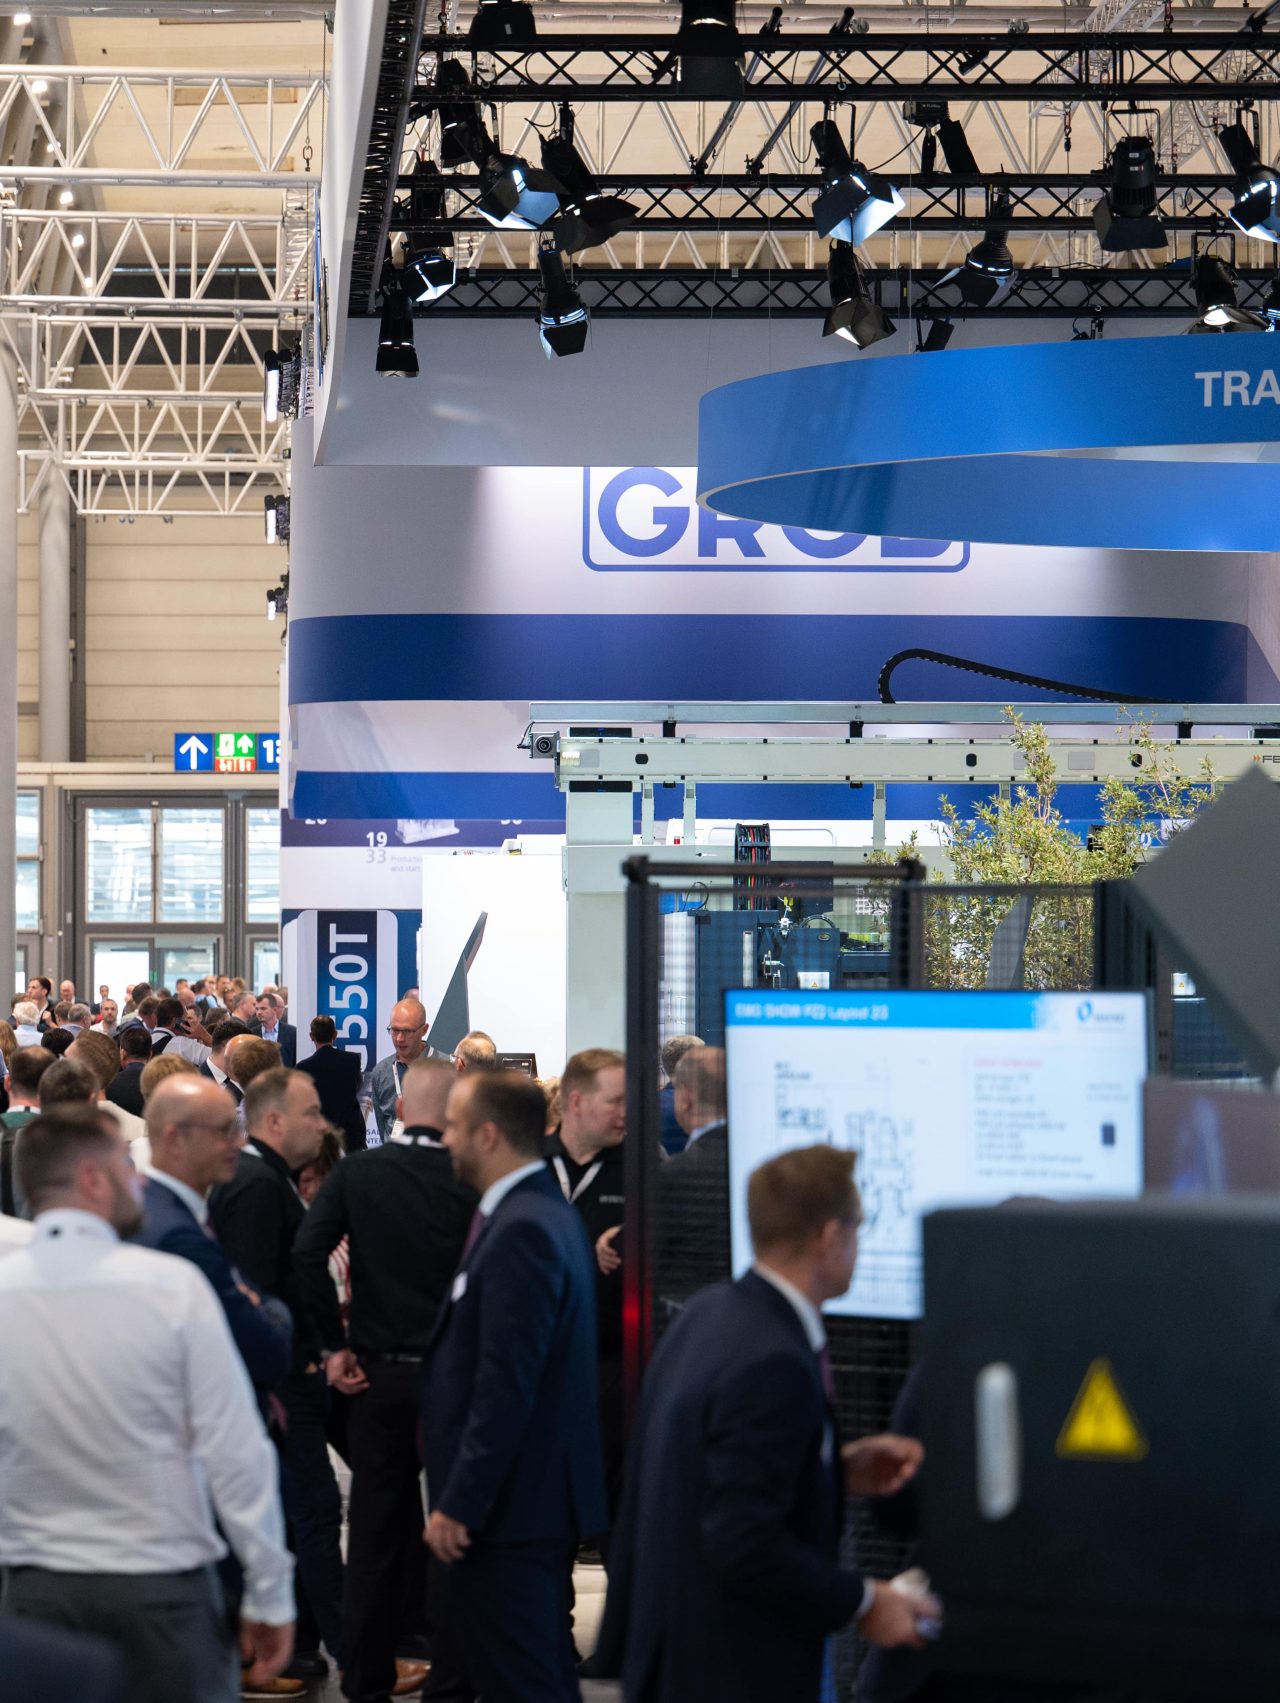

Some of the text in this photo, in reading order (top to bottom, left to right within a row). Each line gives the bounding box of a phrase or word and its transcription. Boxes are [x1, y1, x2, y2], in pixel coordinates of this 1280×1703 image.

[1194, 369, 1280, 408] TRA
[366, 831, 388, 848] 19
[366, 849, 387, 864] 33
